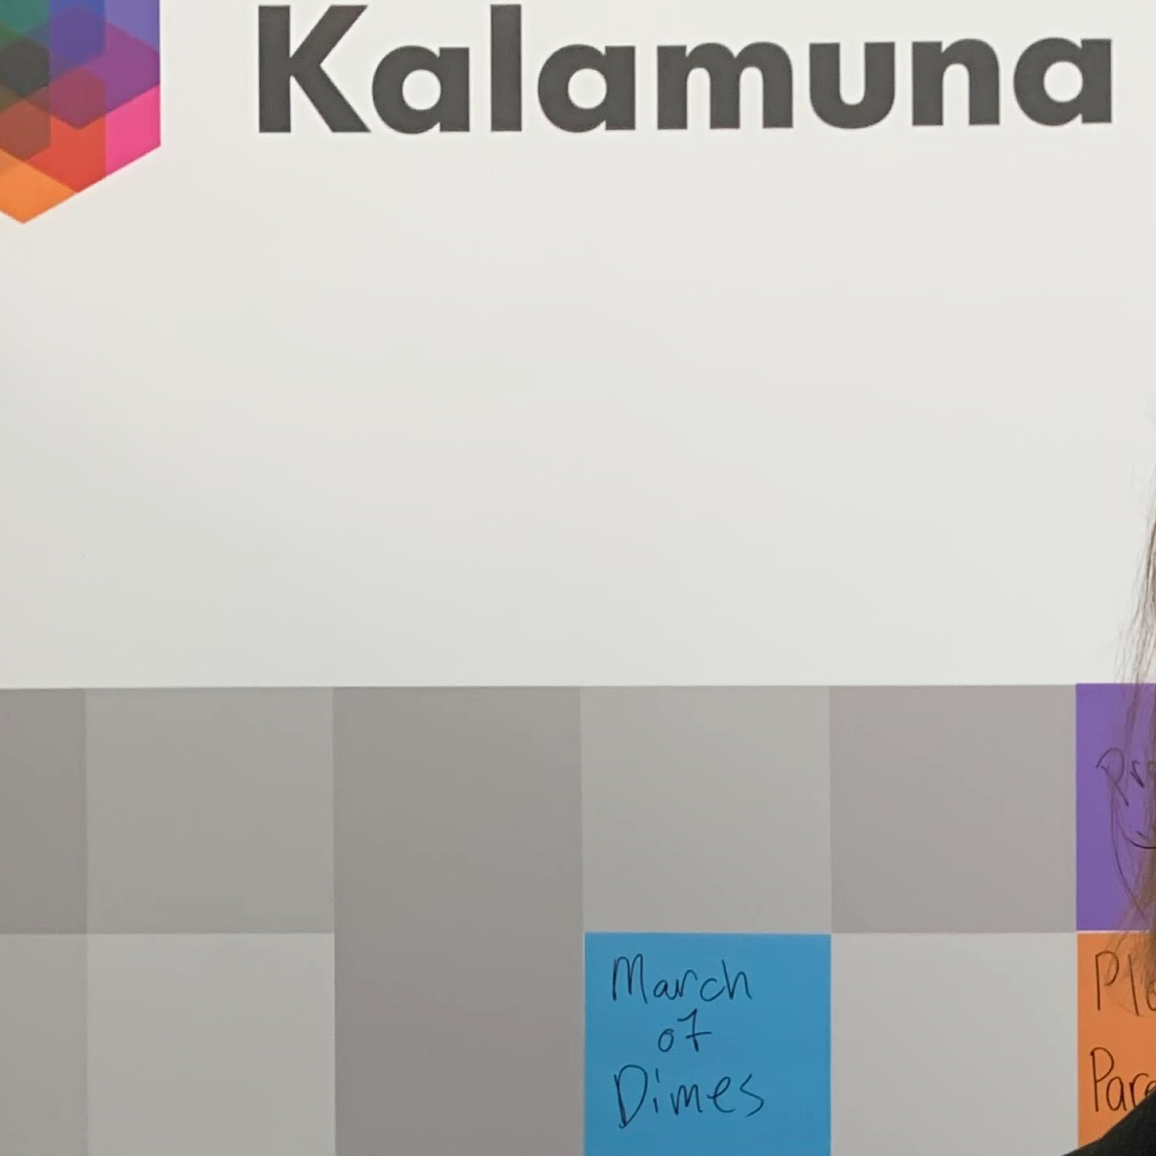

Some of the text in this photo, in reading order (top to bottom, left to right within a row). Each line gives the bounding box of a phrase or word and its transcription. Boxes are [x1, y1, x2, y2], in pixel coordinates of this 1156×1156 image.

[257, 3, 1113, 134] Kalamuna
[612, 953, 753, 1002] March
[657, 1008, 712, 1053] of
[613, 1063, 765, 1129] Dimes
